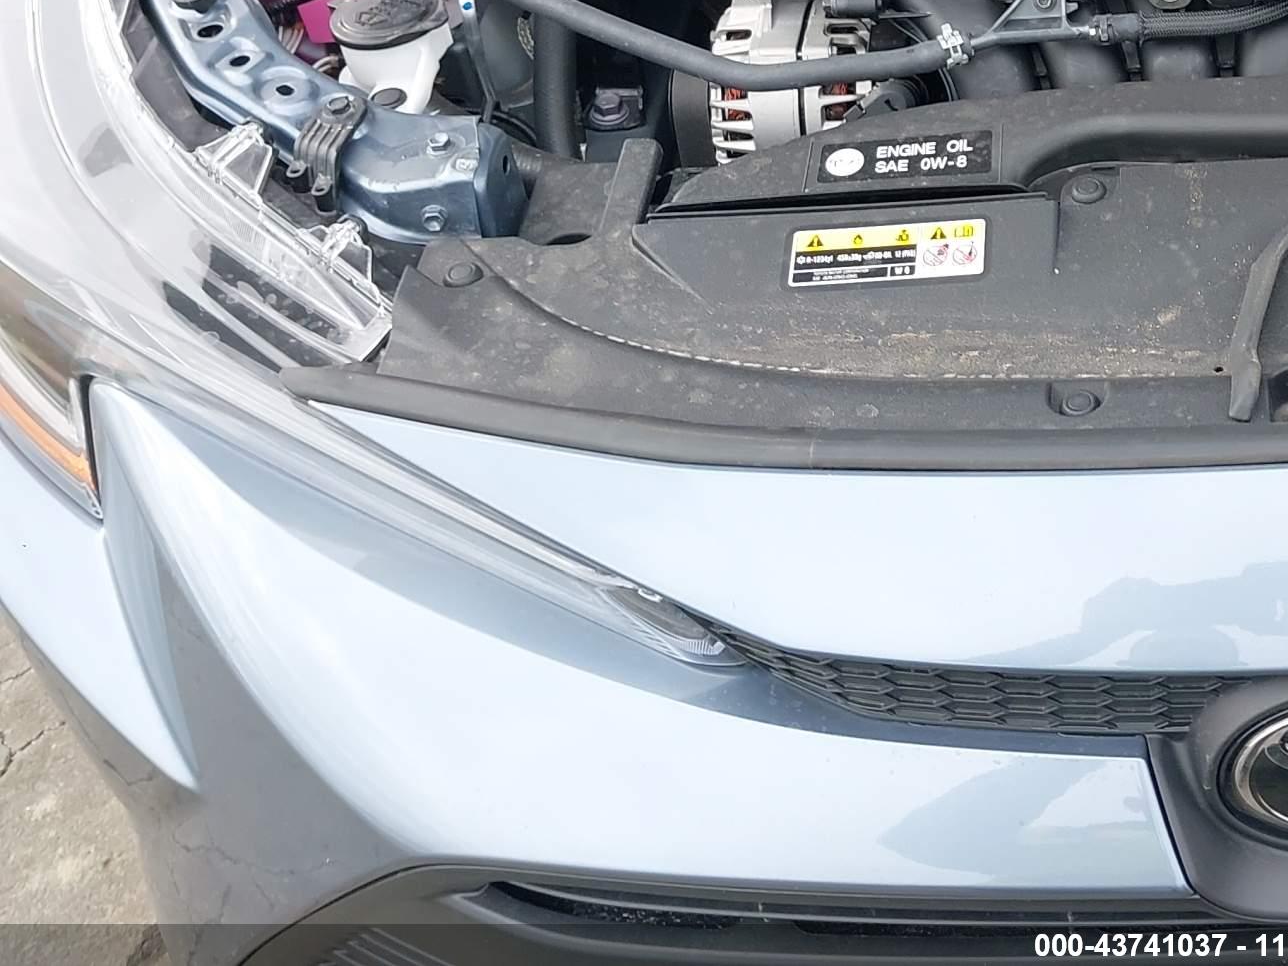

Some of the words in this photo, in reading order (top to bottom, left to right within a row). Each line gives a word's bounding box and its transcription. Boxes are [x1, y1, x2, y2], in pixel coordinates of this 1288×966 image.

[876, 141, 937, 159] ENGINE
[946, 138, 973, 153] OIL
[875, 159, 909, 174] SAE
[920, 154, 968, 171] 0W-8
